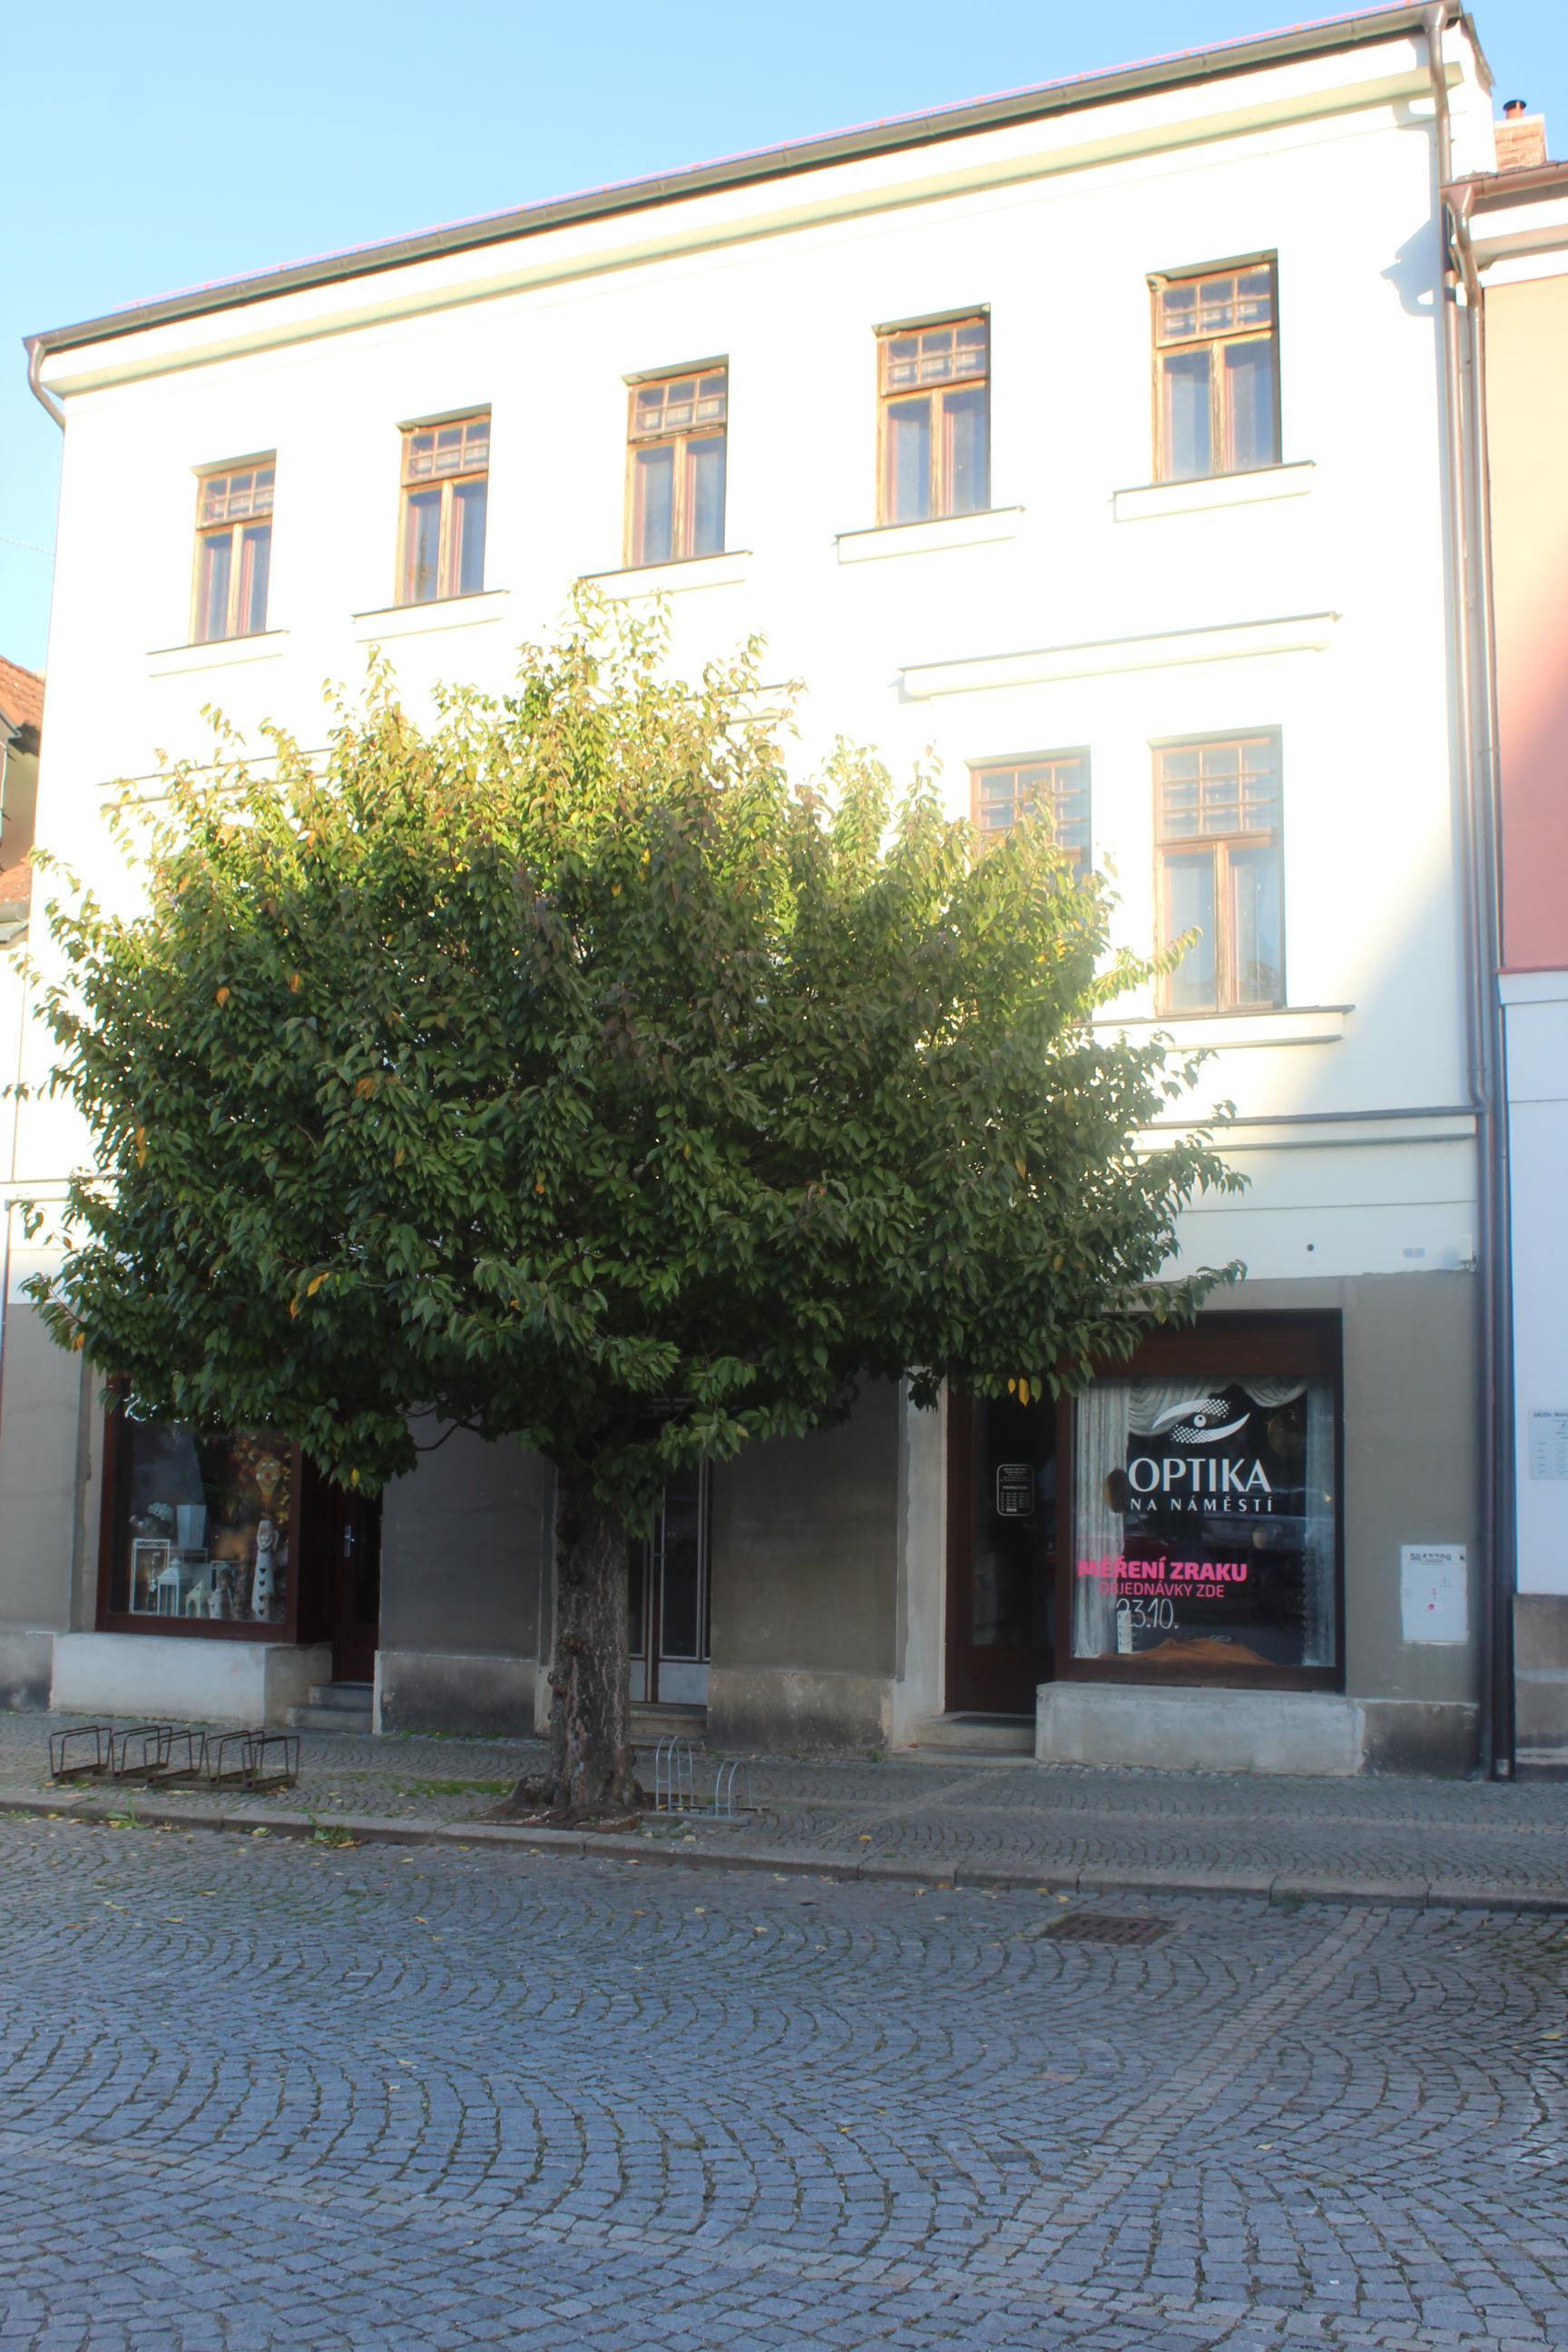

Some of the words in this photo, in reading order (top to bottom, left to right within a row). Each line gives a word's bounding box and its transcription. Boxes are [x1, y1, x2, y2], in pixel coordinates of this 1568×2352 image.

[1128, 1457, 1272, 1493] OPTIKA
[1131, 1498, 1157, 1511] NA
[1171, 1495, 1272, 1512] NÁMĚSTÍ
[1077, 1555, 1166, 1580] MĚŘENÍ
[1170, 1562, 1248, 1582] ZRAKU
[1098, 1580, 1193, 1597] OBJEDNÁVKY
[1196, 1583, 1225, 1598] ZDE
[1116, 1598, 1180, 1630] 23.10.
